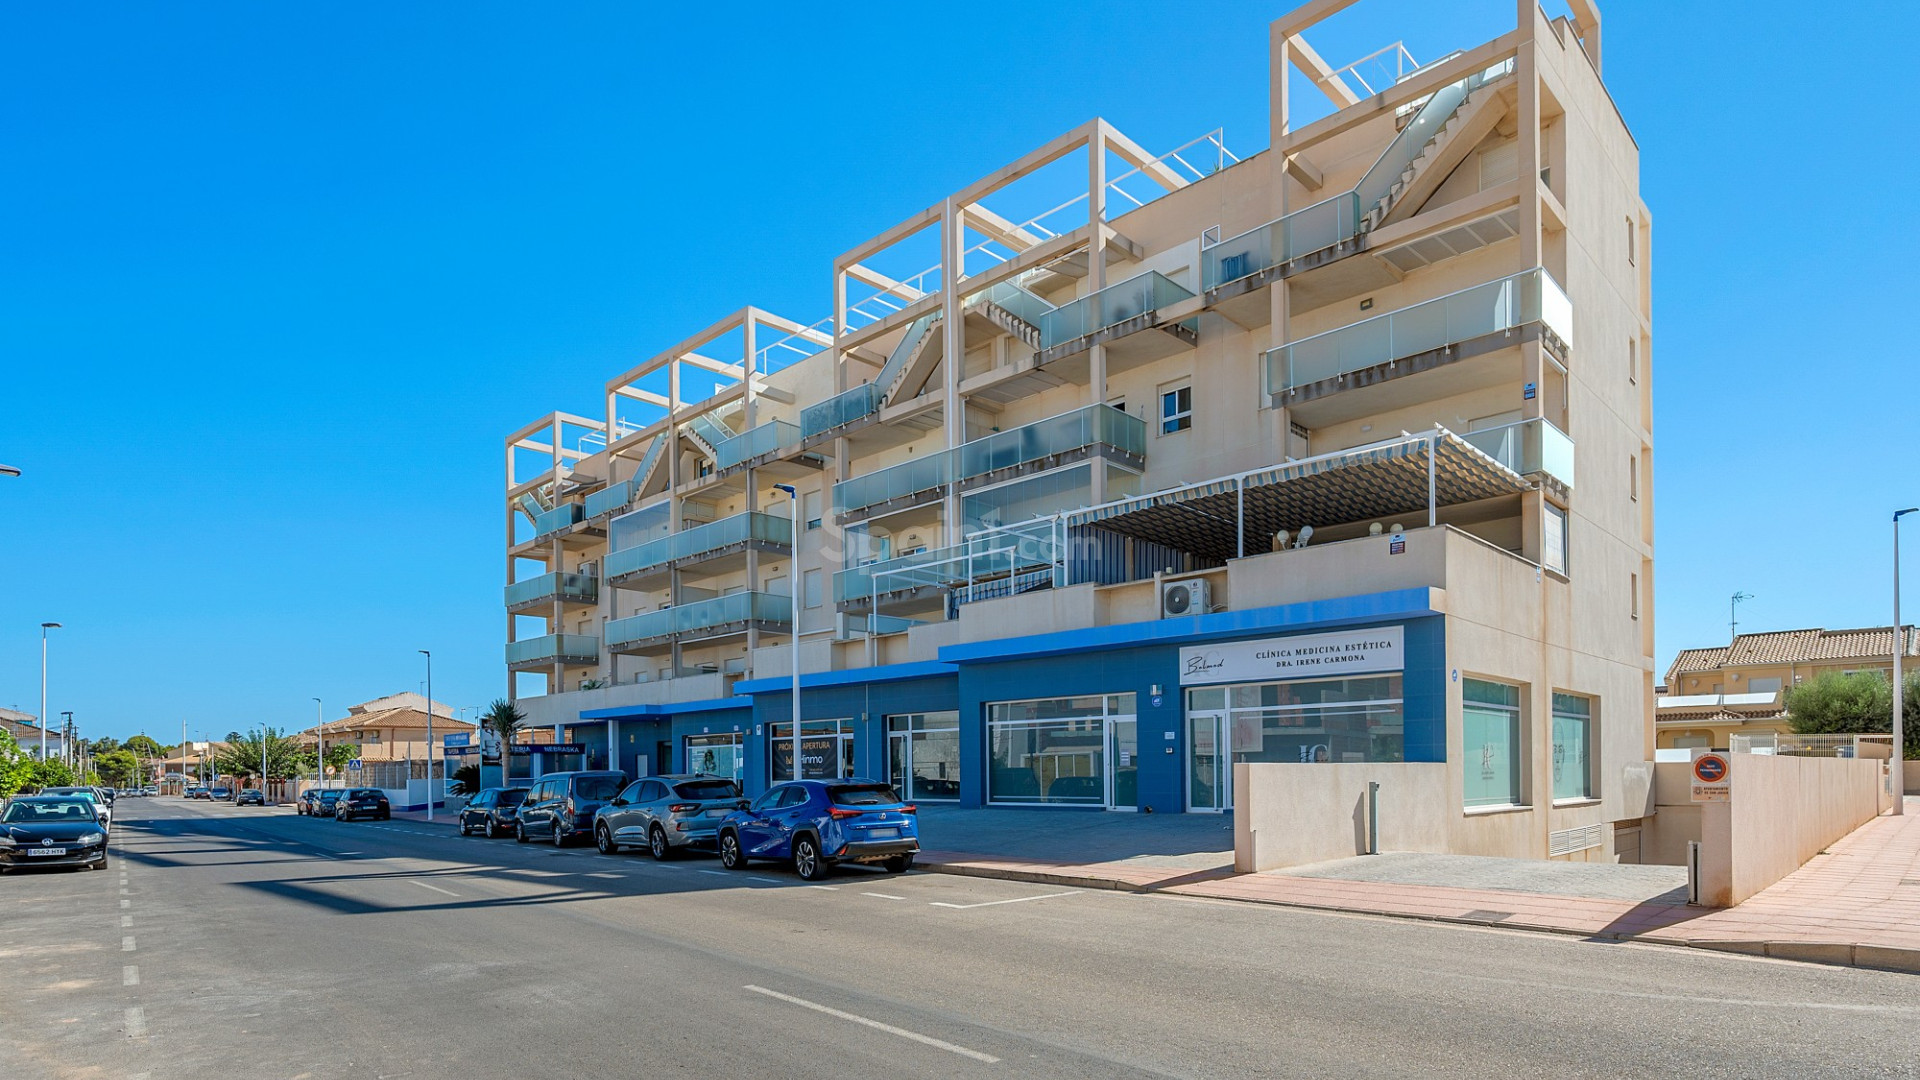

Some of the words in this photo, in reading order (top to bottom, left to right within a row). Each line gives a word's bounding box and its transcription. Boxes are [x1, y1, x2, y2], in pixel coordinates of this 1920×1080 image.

[1255, 649, 1292, 660] CLÍNICA
[1295, 645, 1341, 656] MEDICINA
[1345, 640, 1393, 652] ESTÉTICA
[1296, 657, 1321, 667] IRENE
[1324, 654, 1366, 665] CARMONA
[802, 741, 831, 750] APERTURA
